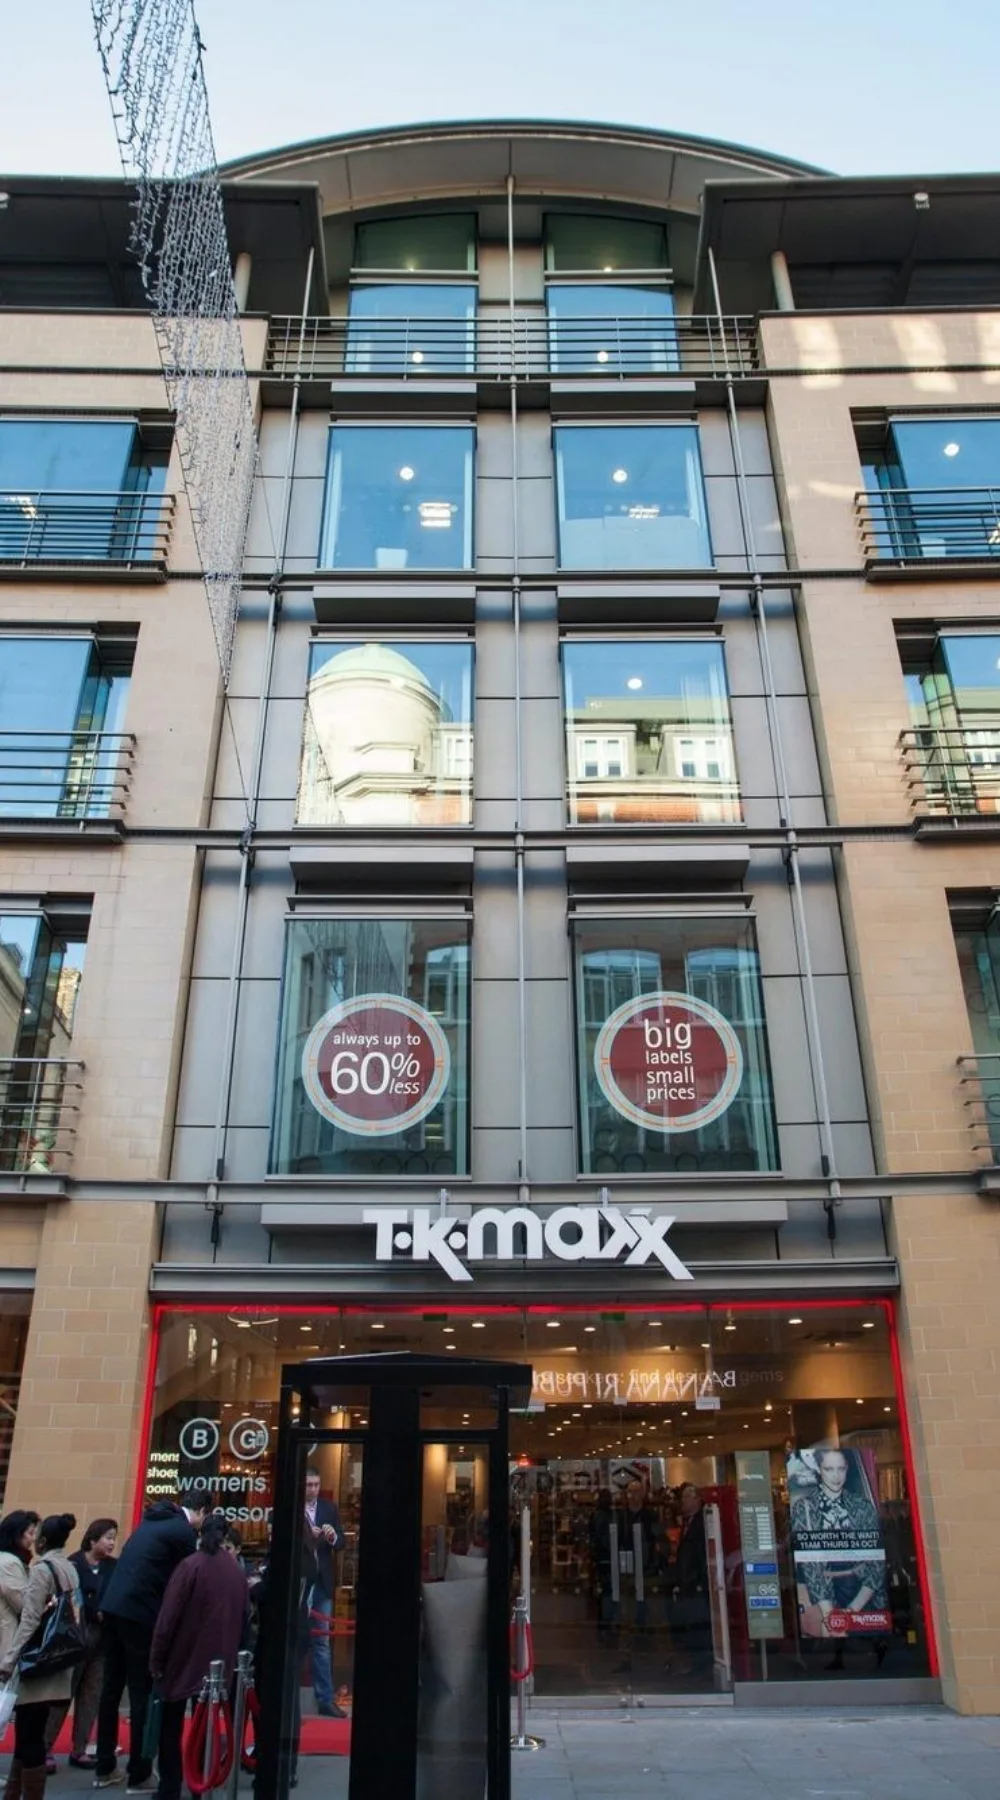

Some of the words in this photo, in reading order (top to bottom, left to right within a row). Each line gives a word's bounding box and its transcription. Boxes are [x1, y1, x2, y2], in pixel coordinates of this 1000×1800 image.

[333, 1032, 379, 1047] always
[384, 1034, 402, 1049] up
[406, 1033, 421, 1046] to
[644, 1019, 692, 1050] big
[644, 1050, 692, 1065] labels
[330, 1050, 420, 1095] 60%
[388, 1077, 420, 1095] less
[646, 1066, 695, 1085] small
[646, 1085, 696, 1104] prices
[192, 1430, 208, 1448] B
[175, 1476, 267, 1493] womens
[211, 1505, 273, 1522] essor
[796, 1532, 809, 1541] SO
[809, 1531, 840, 1541] WORTH
[840, 1531, 857, 1540] THE
[801, 1540, 821, 1549] 11AM
[822, 1540, 849, 1549] THURS
[850, 1540, 860, 1548] 24
[861, 1540, 878, 1548] OCT
